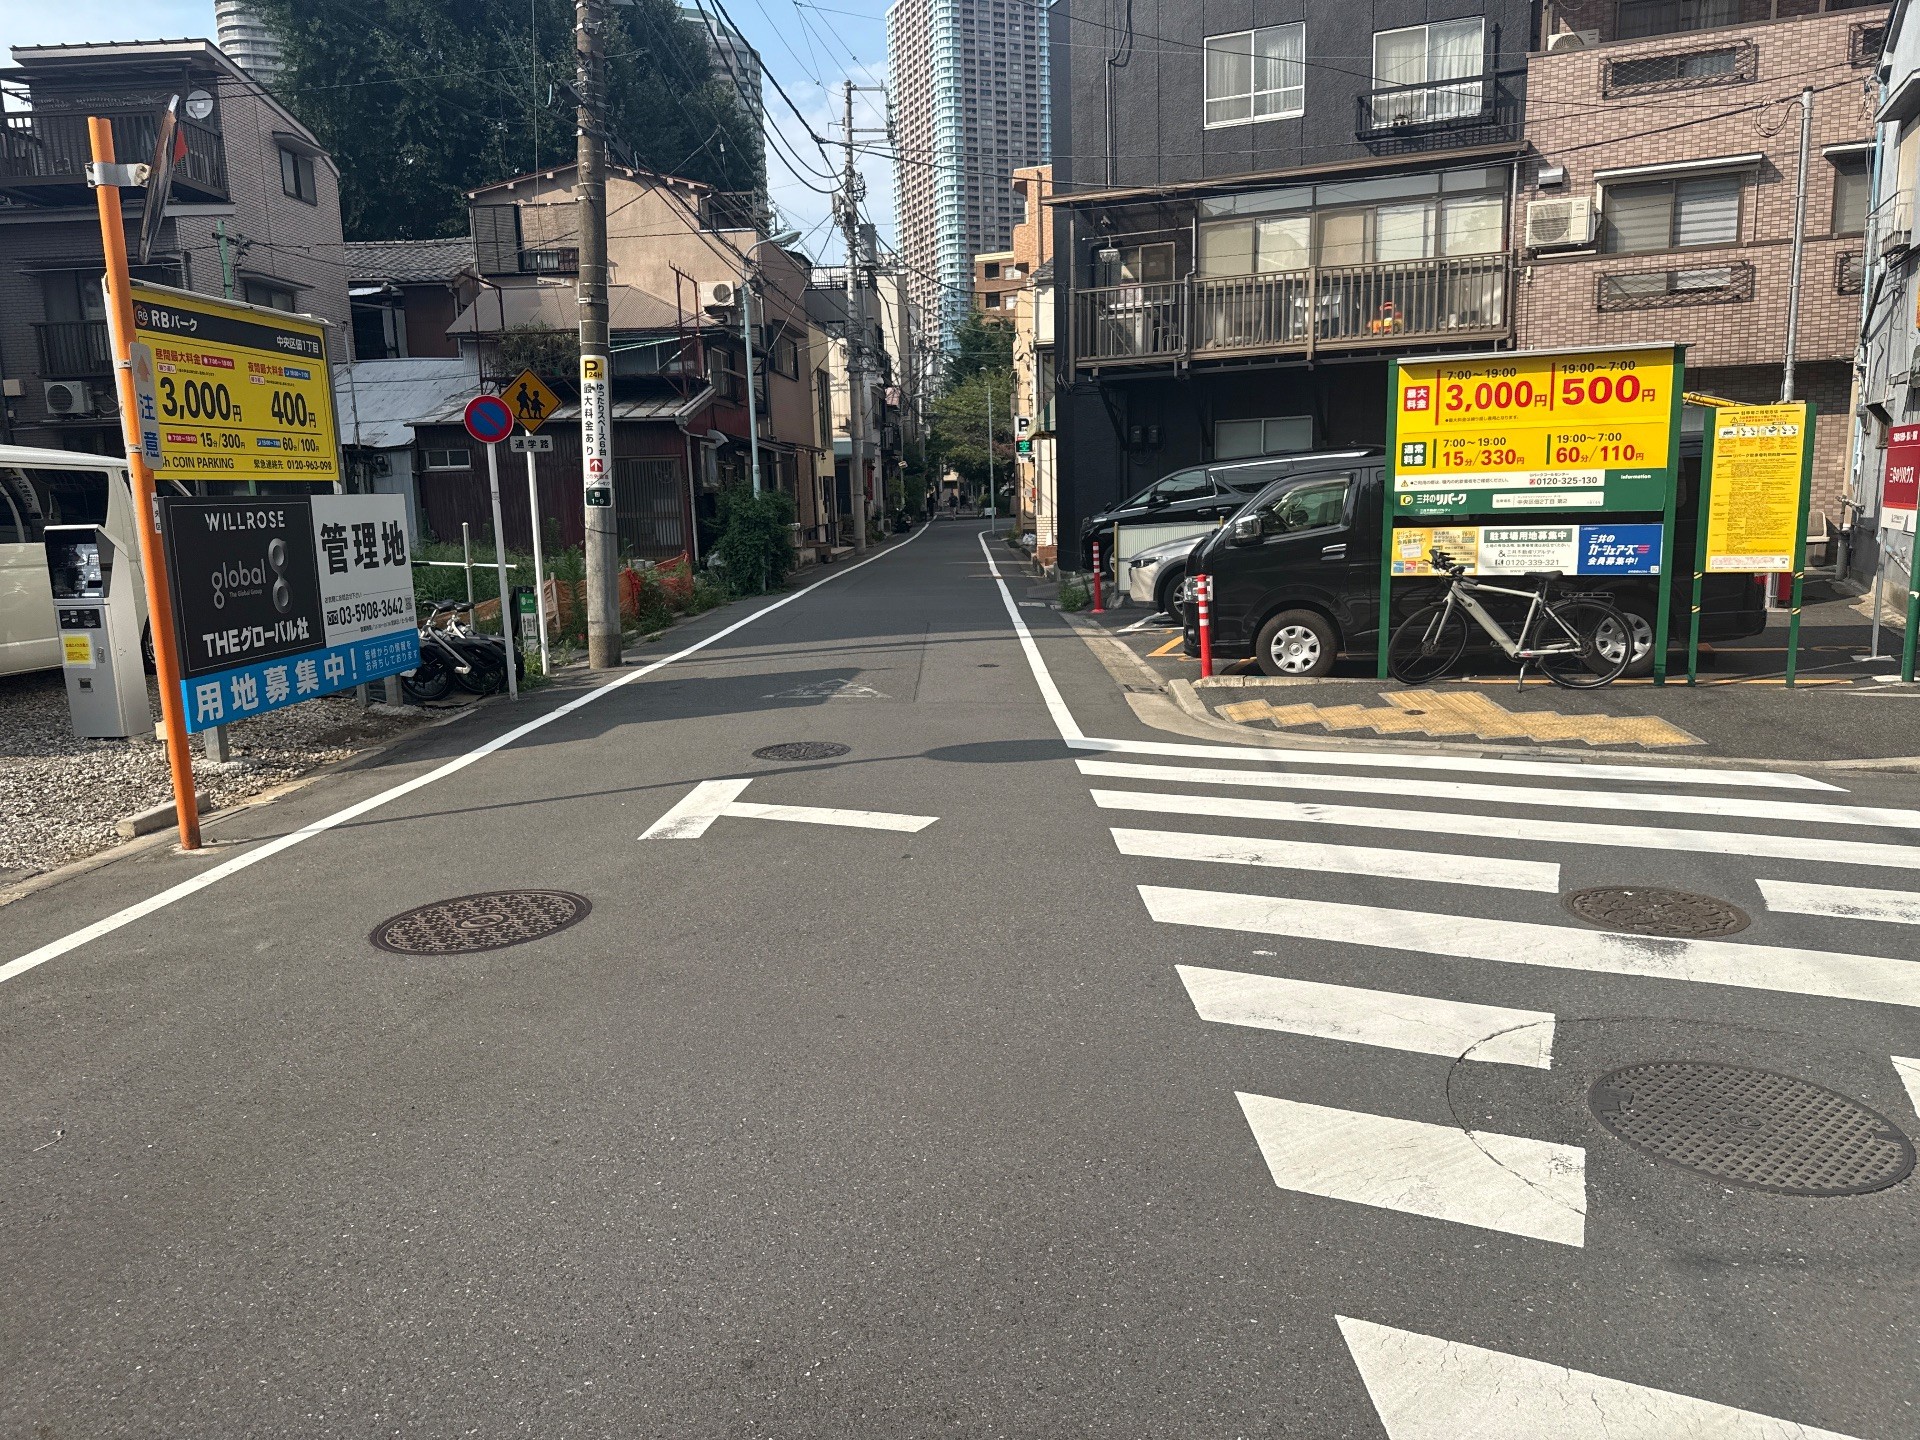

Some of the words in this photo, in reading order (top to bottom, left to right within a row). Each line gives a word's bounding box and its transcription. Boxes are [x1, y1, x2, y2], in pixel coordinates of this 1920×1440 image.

[151, 309, 198, 332] RBパーク
[588, 371, 603, 379] 24H
[139, 393, 160, 458] 注意
[515, 439, 549, 449] 通学路
[172, 456, 196, 468] COIN
[197, 457, 235, 469] PARKING
[1536, 476, 1598, 486] 0120-325-130
[1416, 492, 1467, 506] 三井のリパーク
[204, 510, 286, 532] WILLROSE
[320, 519, 407, 575] 管理地
[1588, 534, 1616, 544] 三井の
[211, 558, 267, 610] global
[339, 596, 404, 626] 03-5908-3642
[202, 616, 310, 658] THEグローバル社
